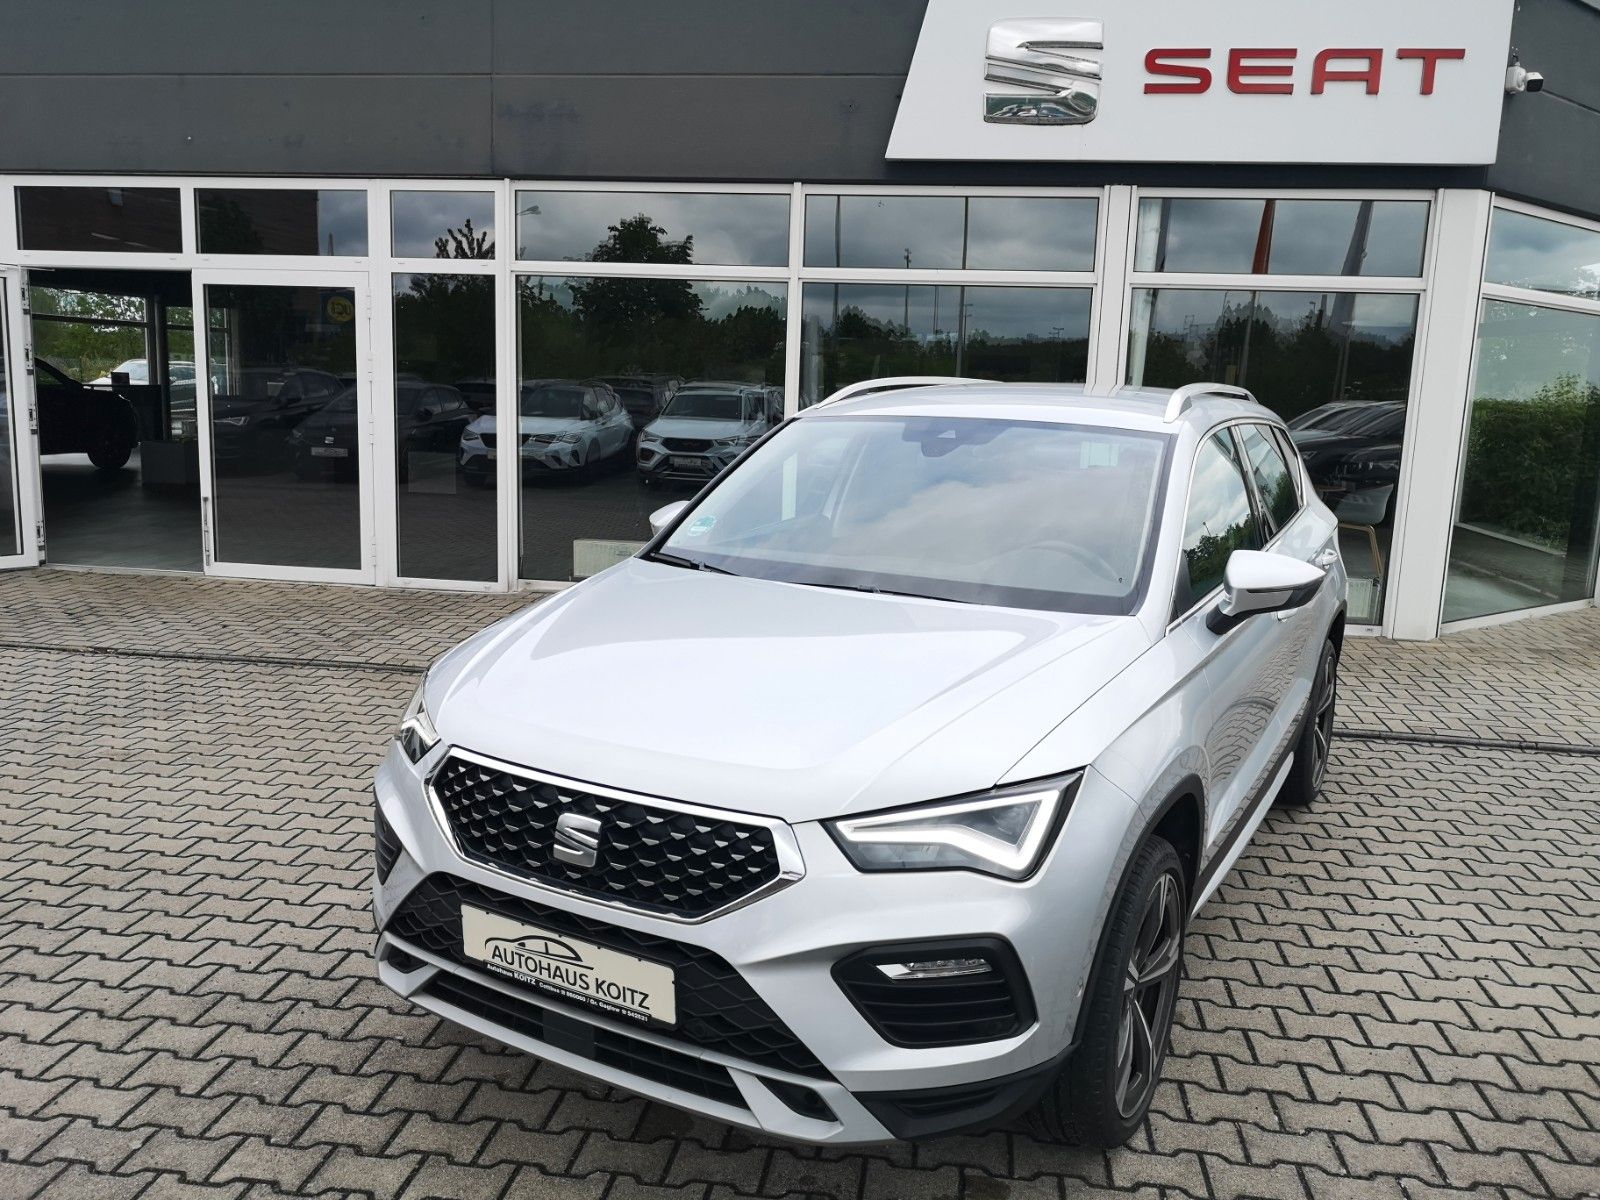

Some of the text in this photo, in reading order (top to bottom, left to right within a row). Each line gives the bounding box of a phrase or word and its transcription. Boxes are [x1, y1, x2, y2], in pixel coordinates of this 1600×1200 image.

[1143, 48, 1466, 95] SEAT
[486, 963, 513, 977] Autohaus
[513, 972, 536, 985] KOITZ
[491, 944, 650, 1010] AUTOHAUS KOITZ
